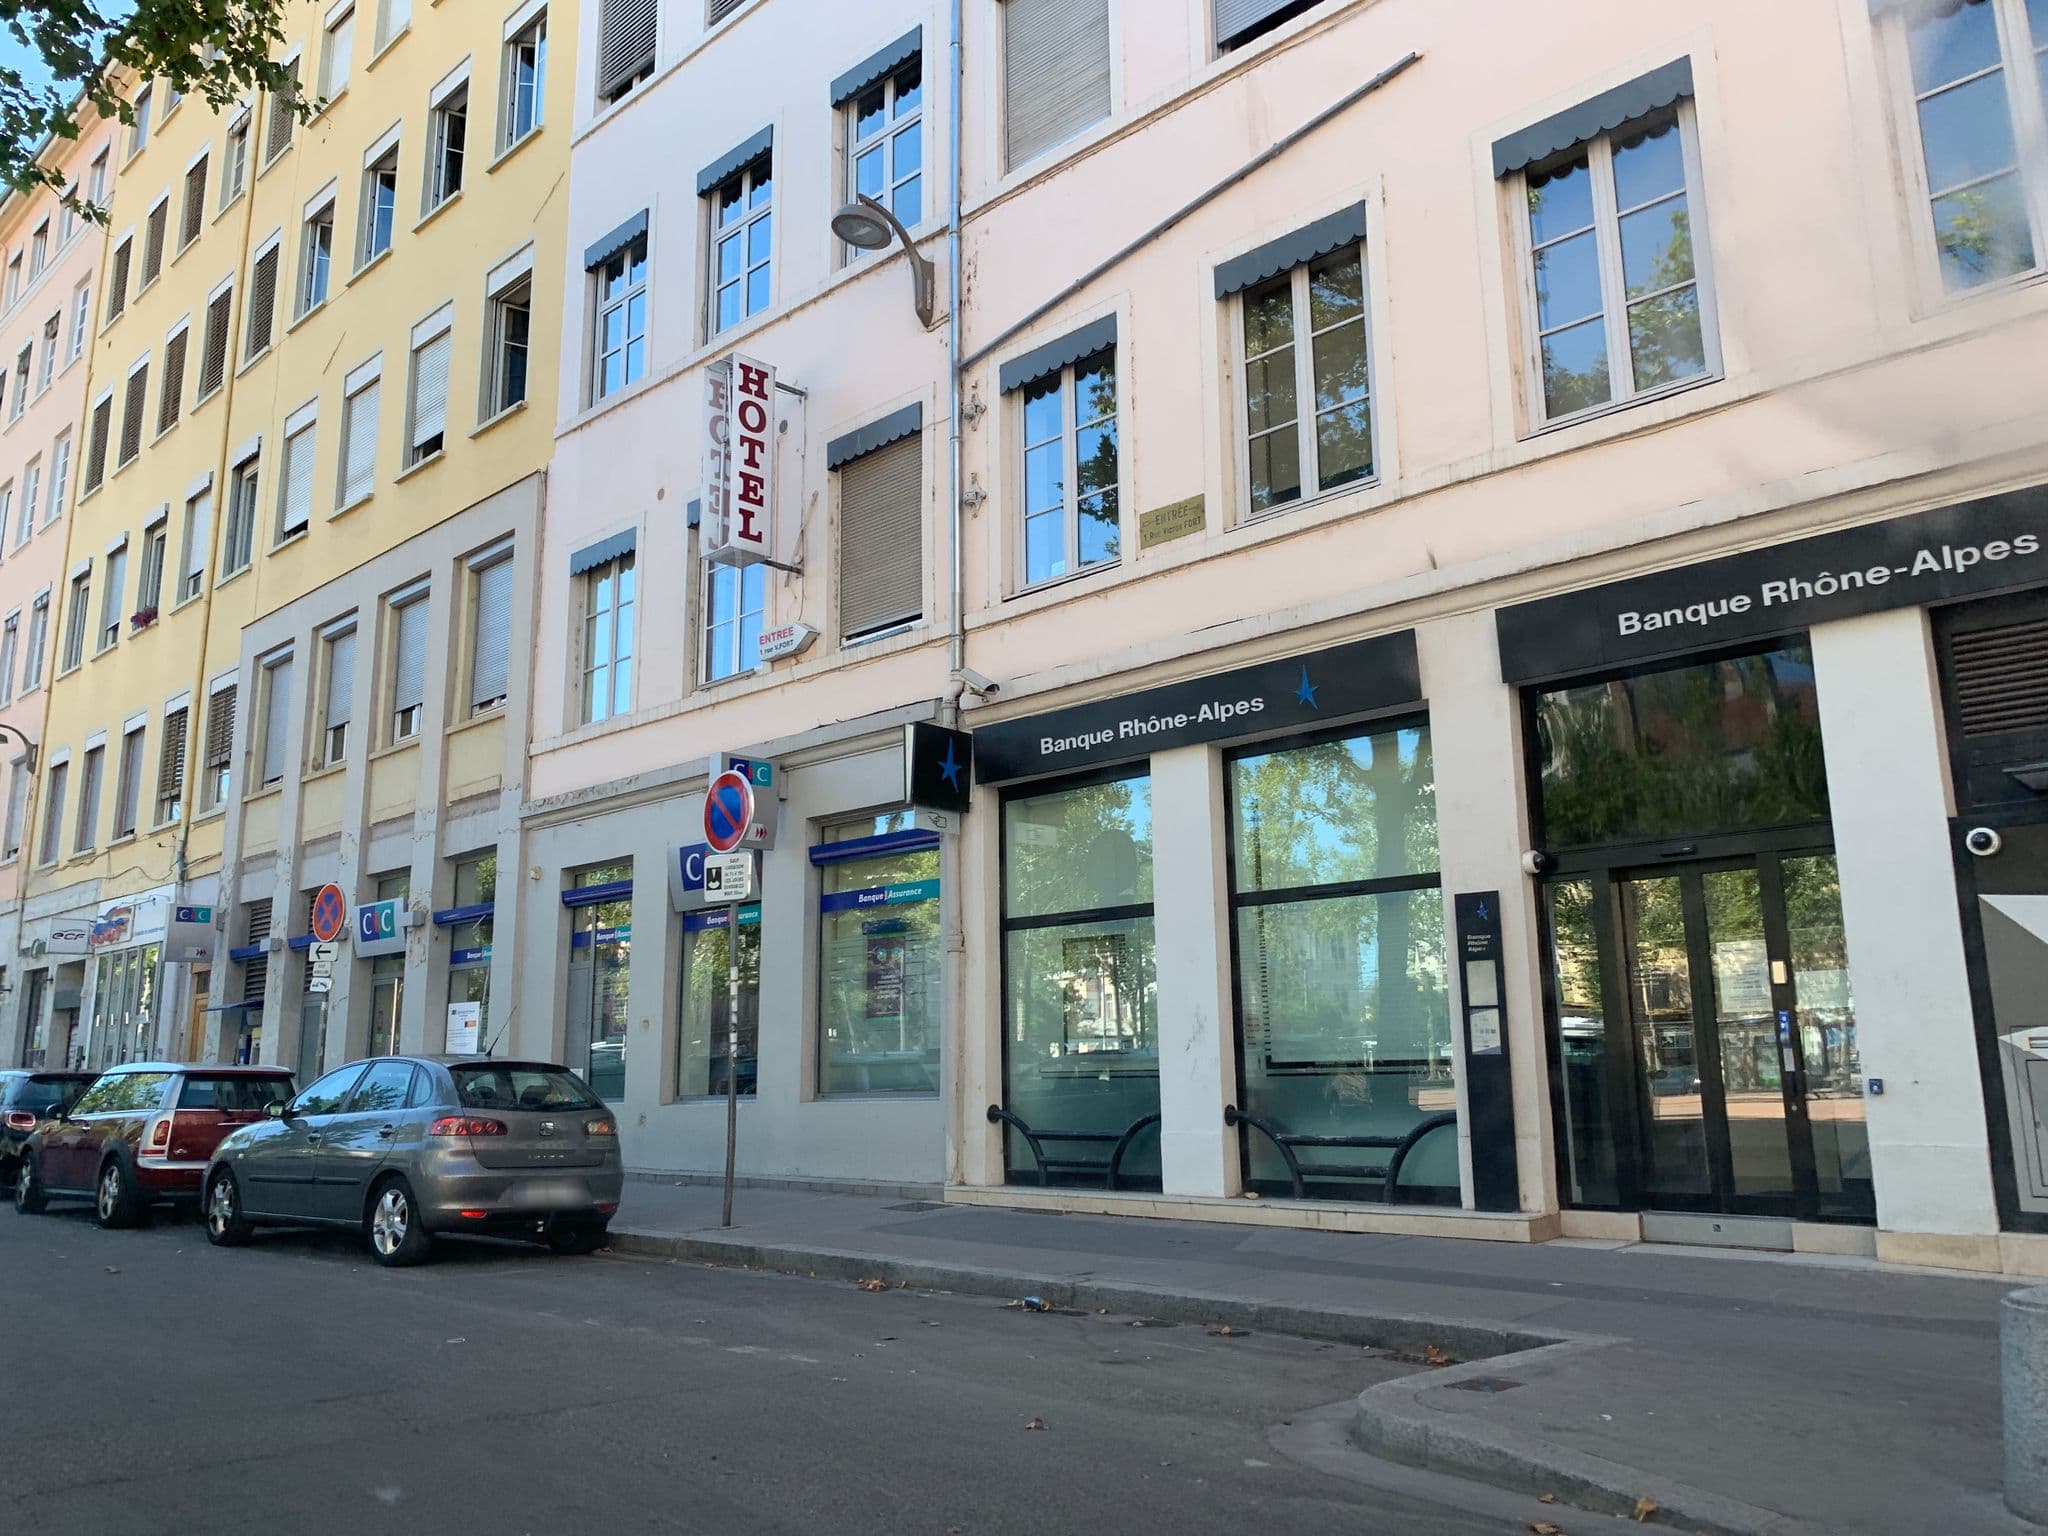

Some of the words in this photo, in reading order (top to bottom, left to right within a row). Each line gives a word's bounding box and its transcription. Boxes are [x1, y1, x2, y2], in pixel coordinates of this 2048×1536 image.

[738, 362, 769, 544] HOTEL
[1155, 504, 1188, 526] ENTRÉE
[1617, 591, 1752, 637] Banque
[1761, 532, 2040, 607] Rhône-Alpes
[759, 626, 794, 646] ENTREE
[1040, 726, 1114, 756] Banque
[1119, 694, 1265, 740] Rhône-Alpes
[858, 893, 883, 903] Banque
[888, 888, 922, 898] Assurance
[180, 909, 208, 921] CIC
[362, 909, 392, 935] CIC
[707, 915, 728, 925] Banque
